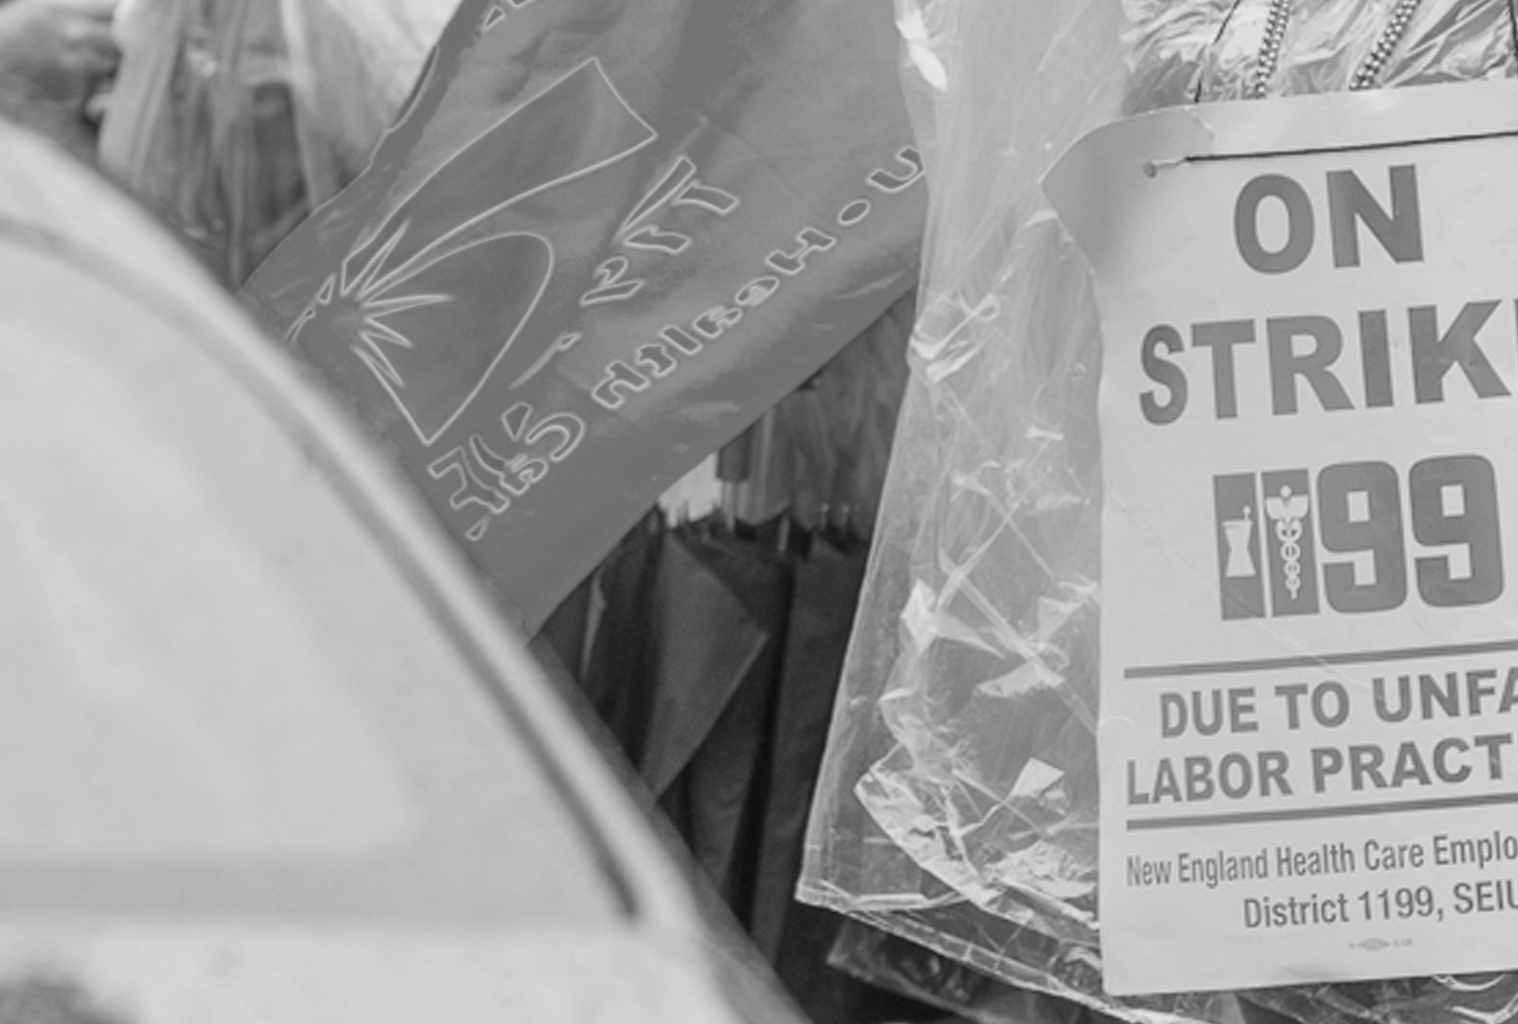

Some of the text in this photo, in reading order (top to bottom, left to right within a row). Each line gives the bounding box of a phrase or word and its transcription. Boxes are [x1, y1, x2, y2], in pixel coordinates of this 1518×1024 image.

[1234, 164, 1424, 275] ON
[1213, 455, 1504, 621] 1199
[1160, 687, 1258, 738] DUE
[1274, 681, 1349, 730] TO
[1128, 751, 1293, 805] LABOR
[1127, 857, 1171, 885] New
[1178, 848, 1268, 889] England
[1276, 842, 1355, 877] Health
[1364, 839, 1424, 871] Care
[1244, 893, 1349, 928] District
[1358, 886, 1443, 921] 1199,
